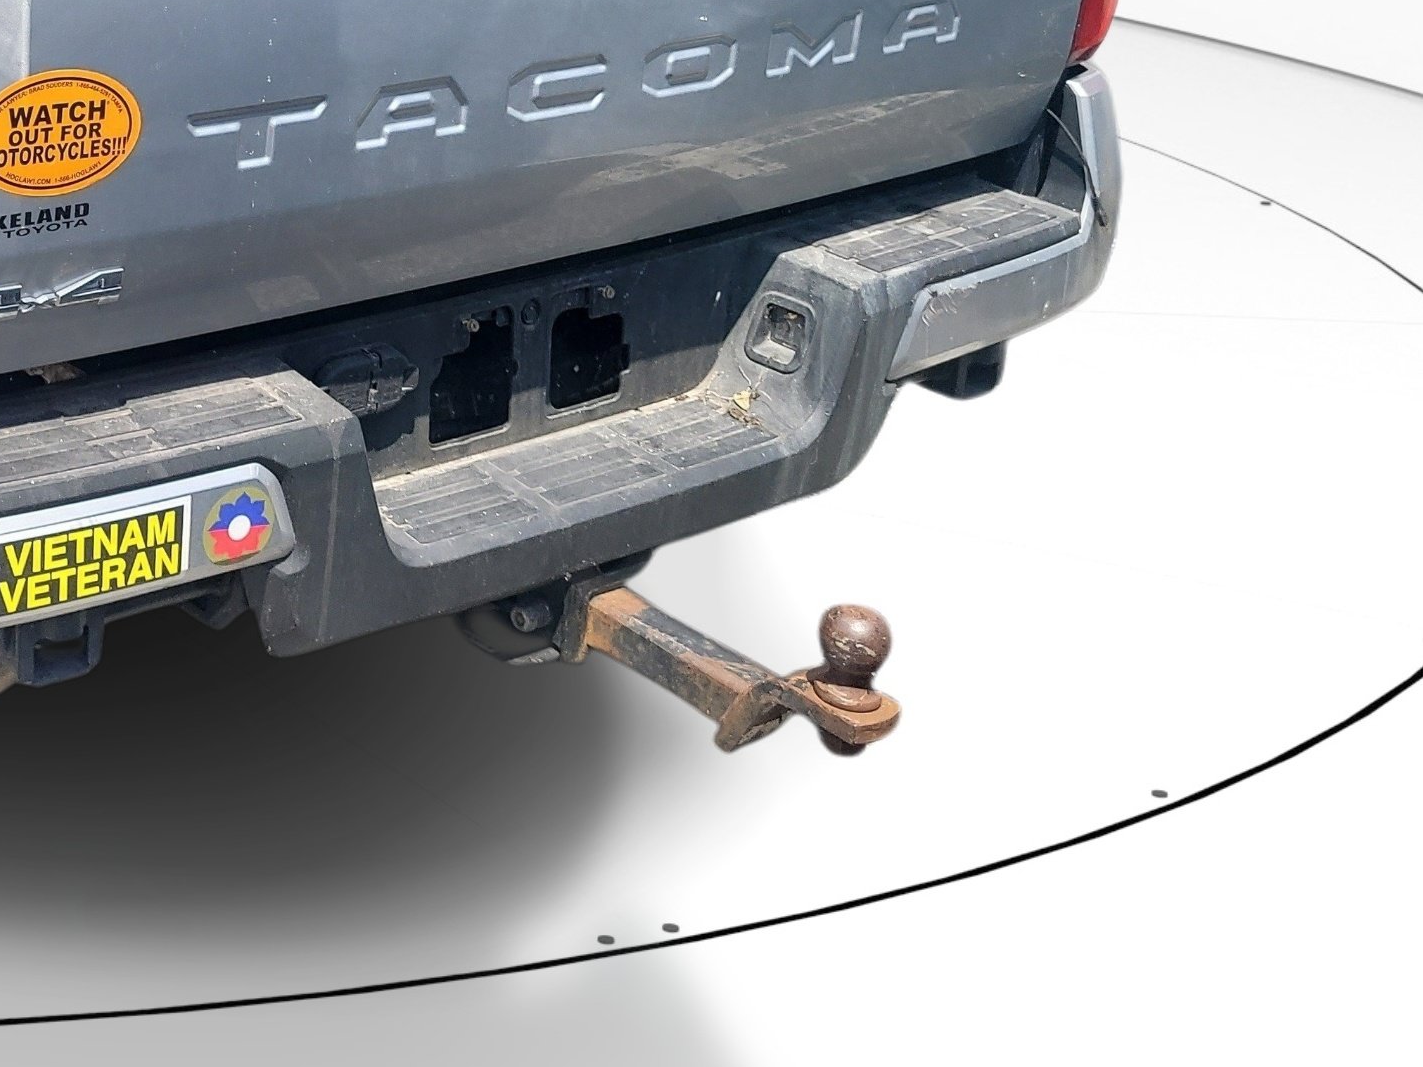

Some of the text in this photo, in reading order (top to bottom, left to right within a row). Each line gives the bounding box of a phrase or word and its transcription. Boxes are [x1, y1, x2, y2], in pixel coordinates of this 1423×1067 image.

[9, 99, 106, 129] WATCH
[8, 123, 102, 148] OUT FOR
[3, 218, 88, 239] TOYOTA
[5, 510, 176, 577] VIETNAM
[0, 544, 180, 614] VETERAN
